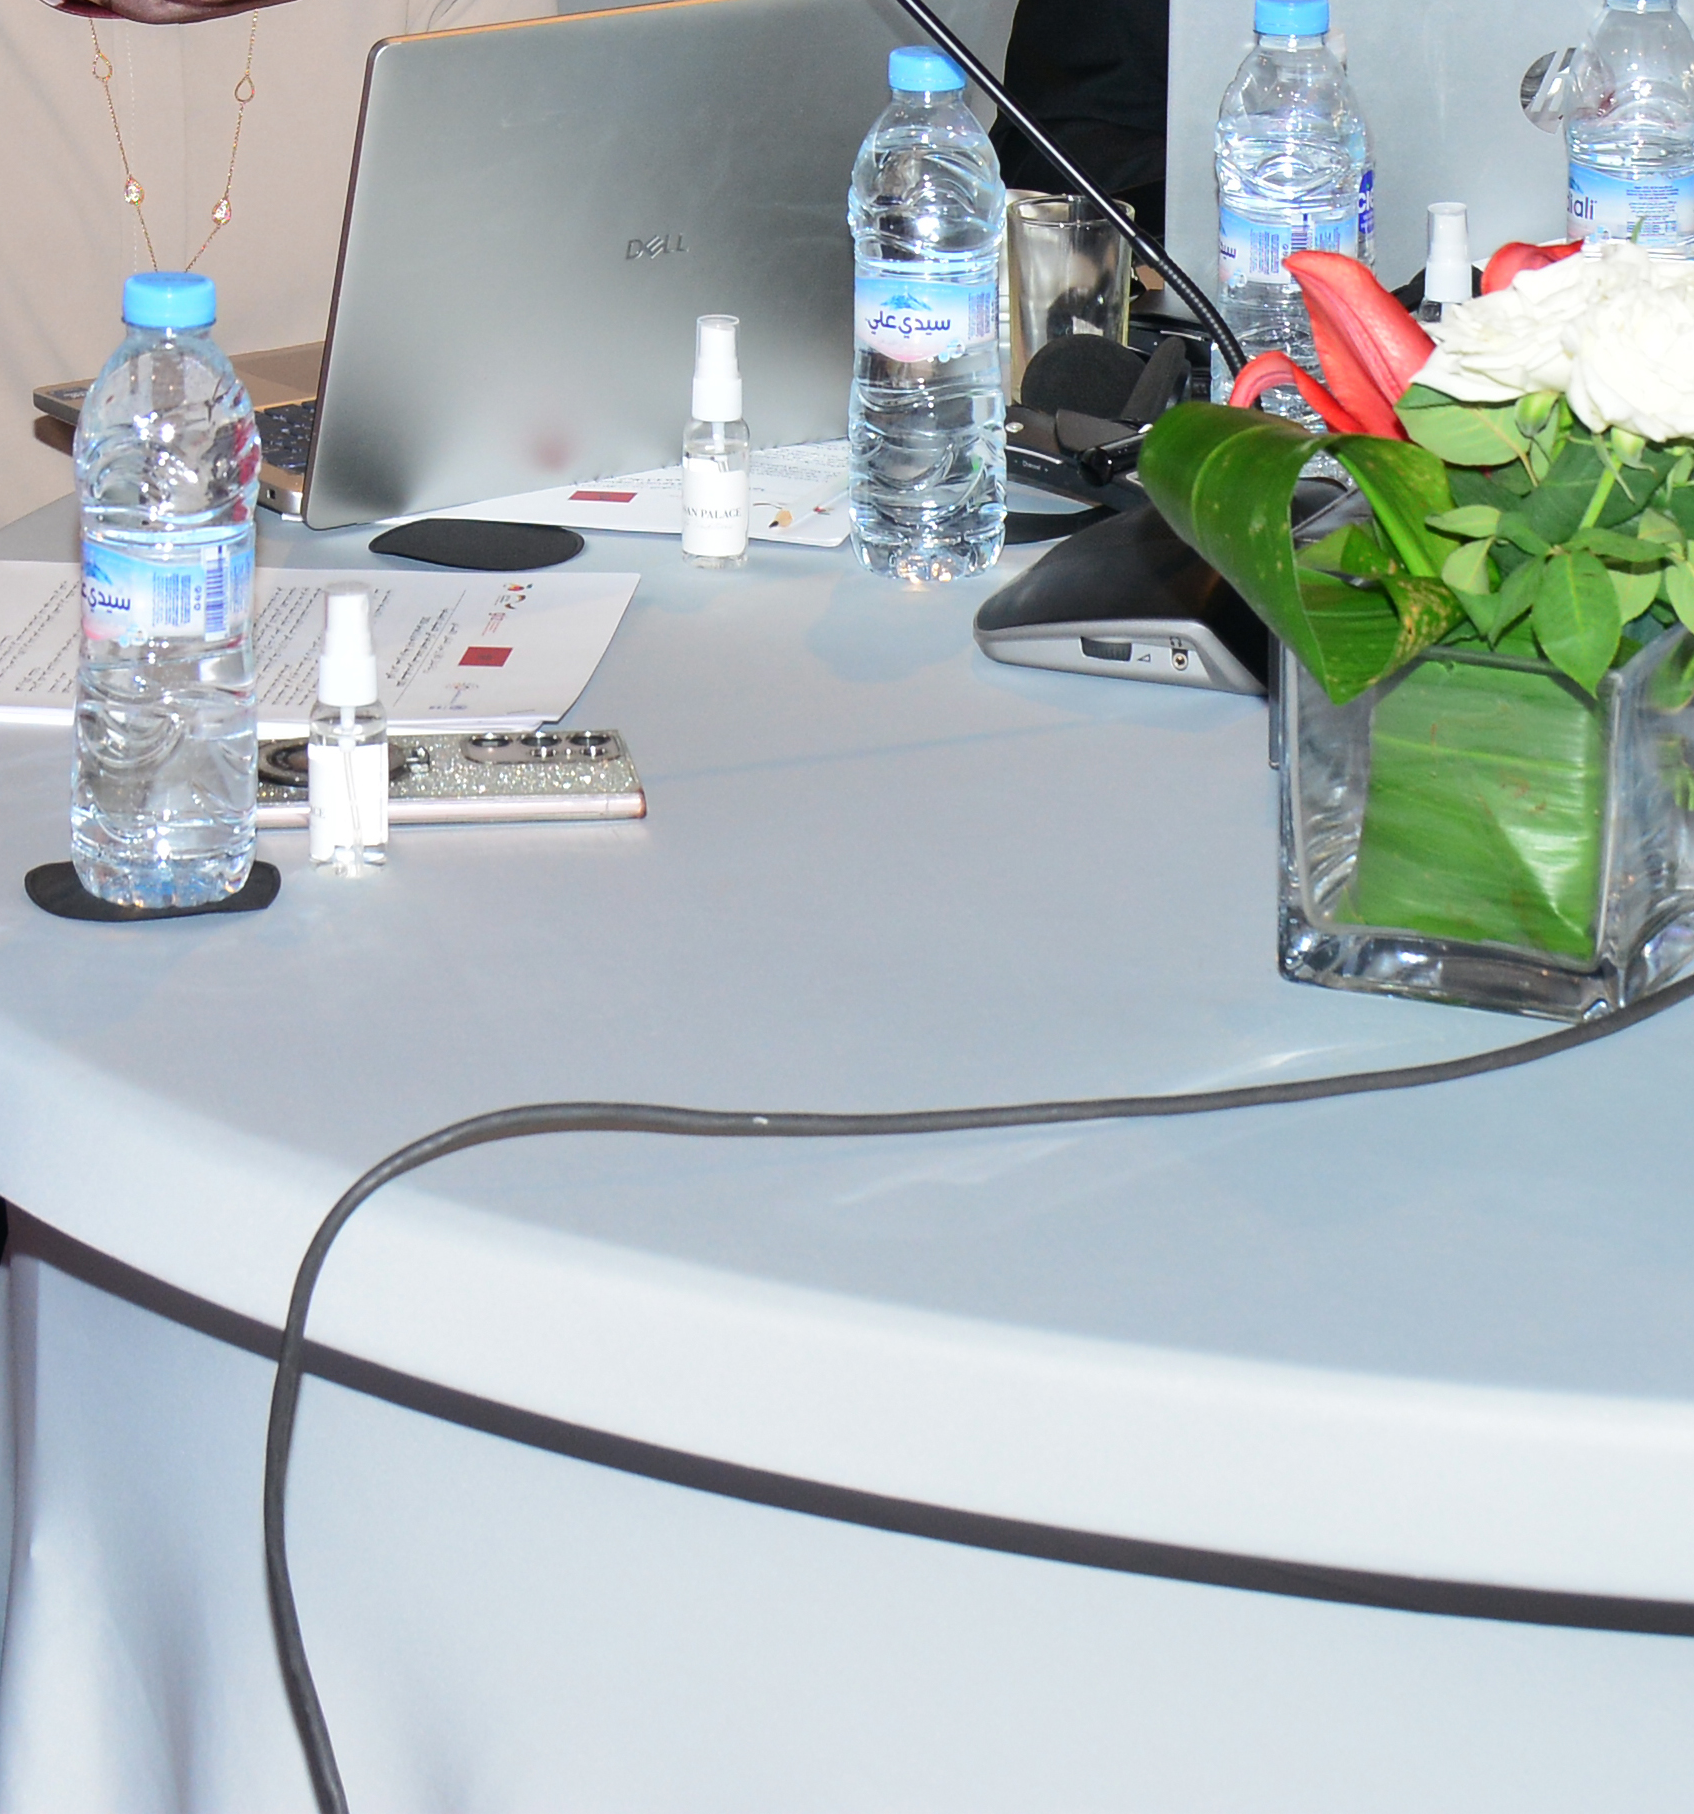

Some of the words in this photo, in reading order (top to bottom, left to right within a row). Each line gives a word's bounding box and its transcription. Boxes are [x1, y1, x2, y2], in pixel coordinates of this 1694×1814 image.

[626, 233, 690, 261] DELL
[866, 310, 897, 335] علي
[898, 317, 951, 339] سيدي
[700, 507, 742, 520] PALACE
[87, 586, 131, 613] سيدي
